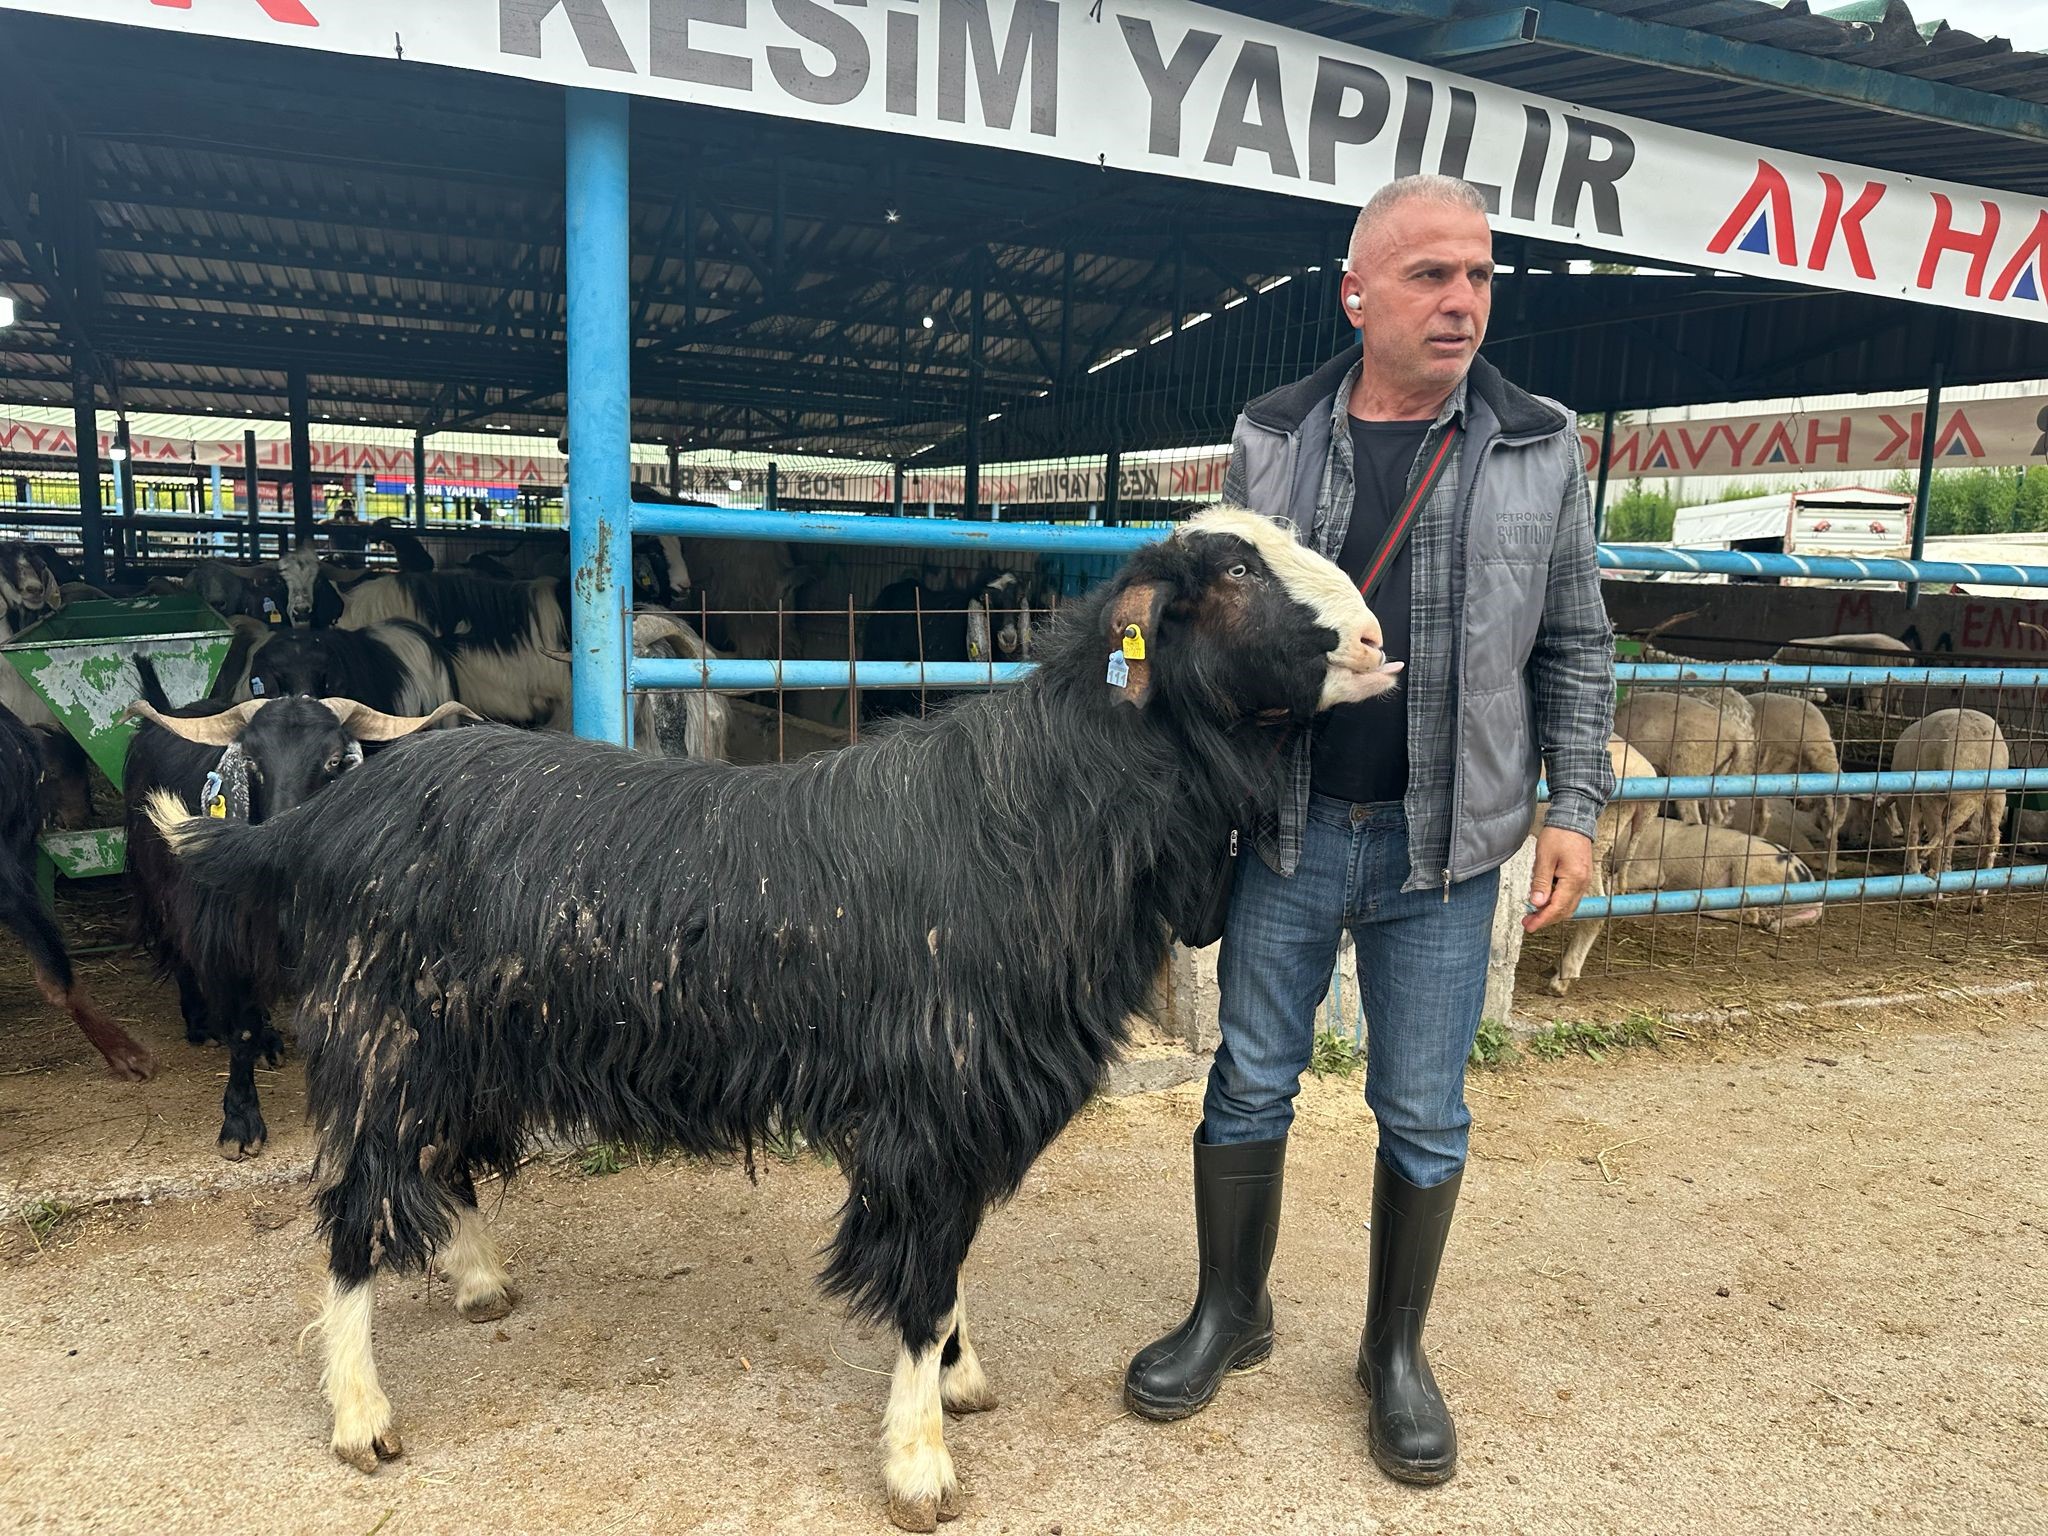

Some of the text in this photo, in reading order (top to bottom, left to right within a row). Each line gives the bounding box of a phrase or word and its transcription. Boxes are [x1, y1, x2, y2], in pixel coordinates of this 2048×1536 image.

[1115, 14, 1635, 237] YAPILIR
[1706, 158, 1887, 280] AK
[445, 485, 489, 498] YAPILIR
[1496, 512, 1553, 522] PETRONAS
[1960, 600, 2048, 652] EMİ
